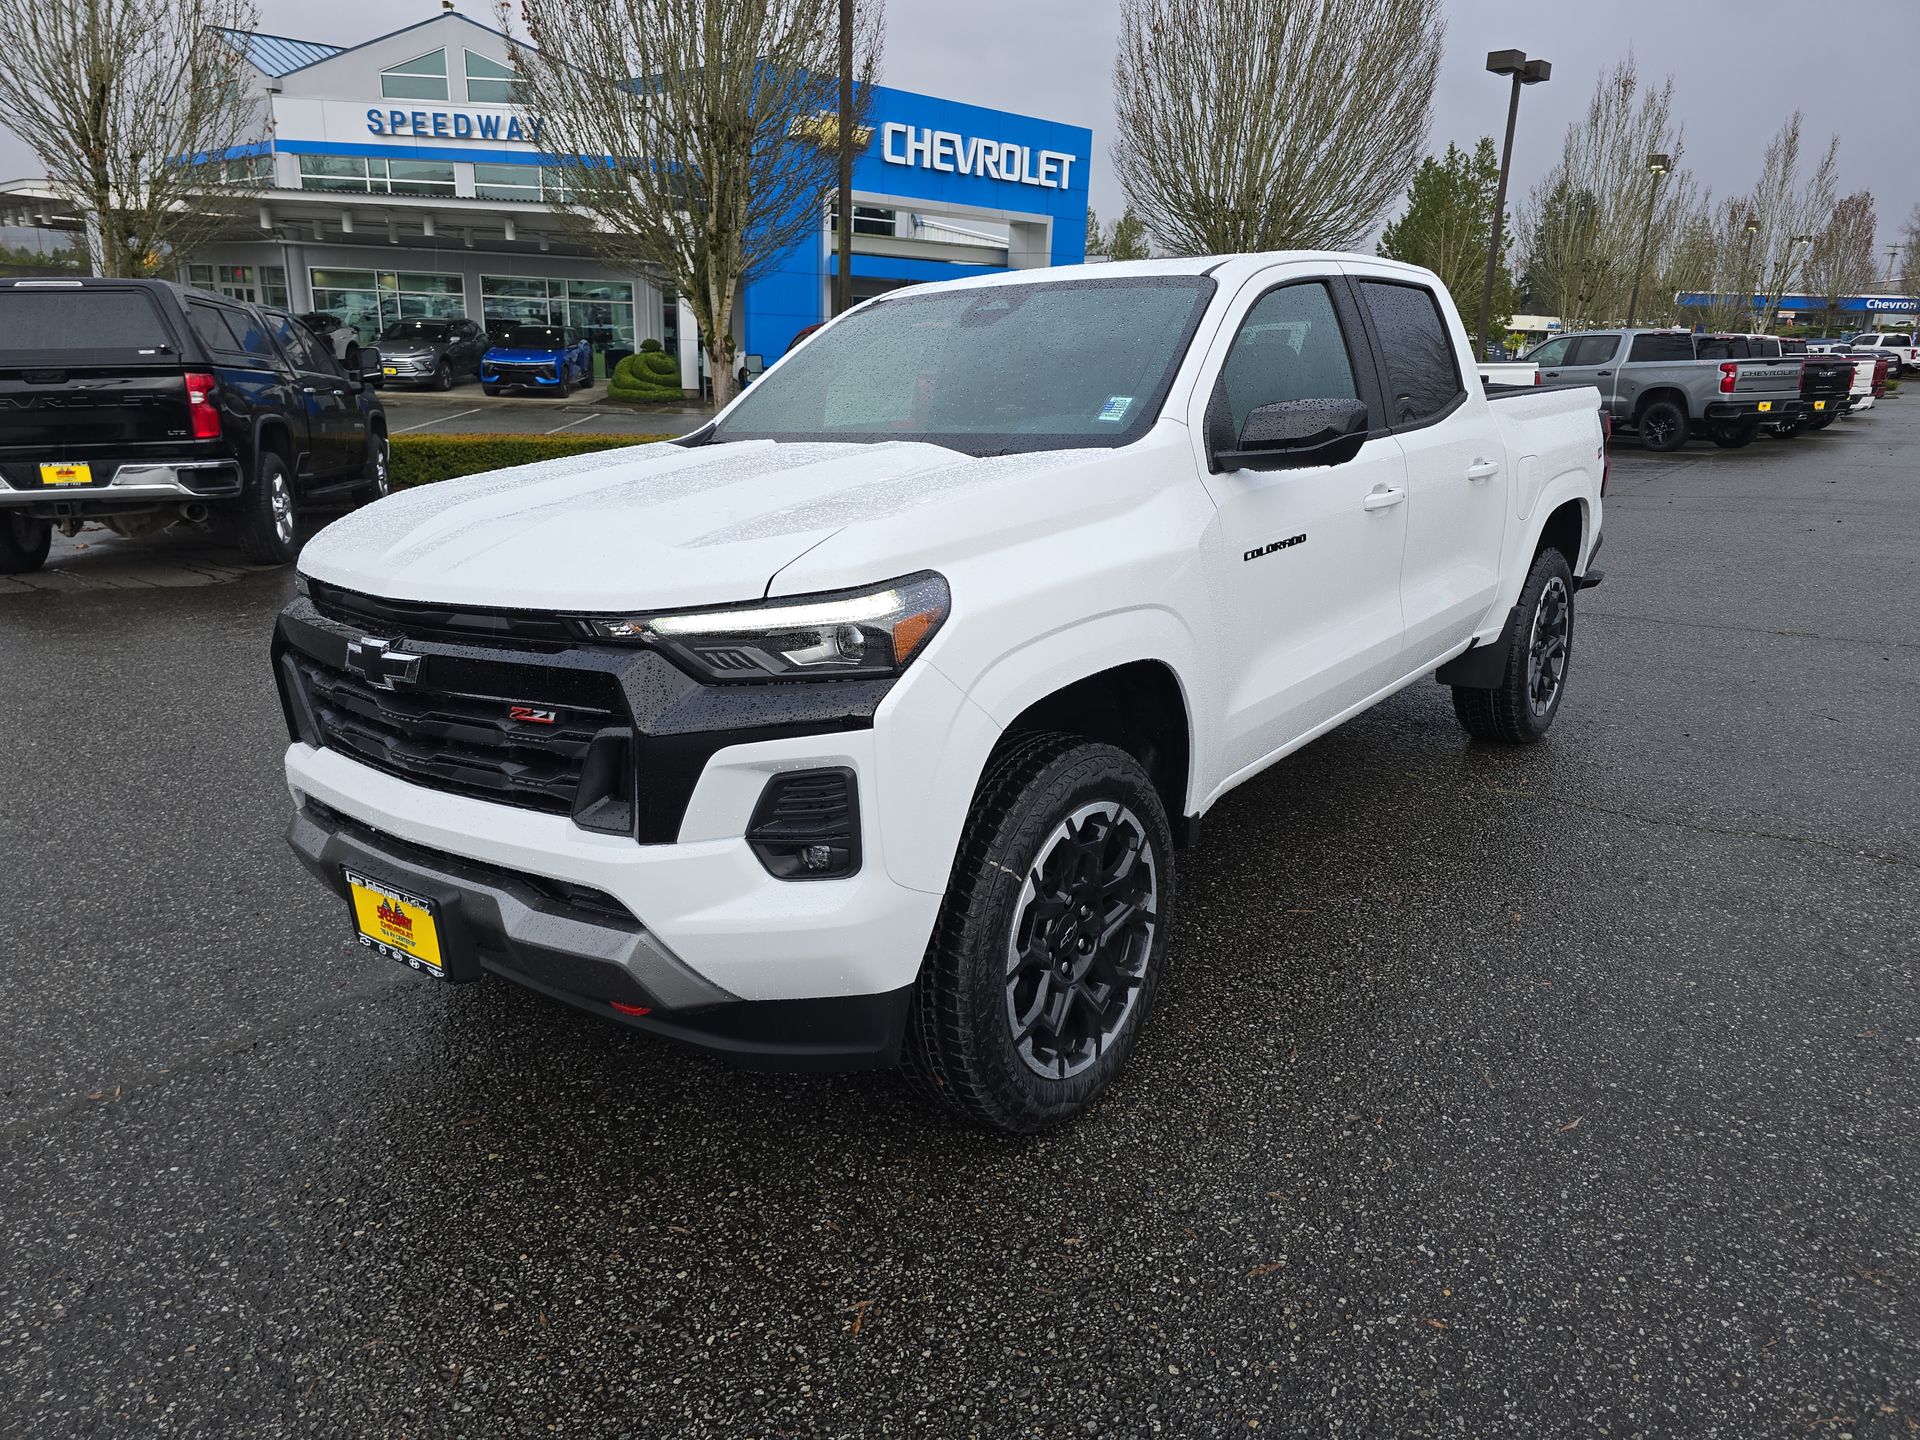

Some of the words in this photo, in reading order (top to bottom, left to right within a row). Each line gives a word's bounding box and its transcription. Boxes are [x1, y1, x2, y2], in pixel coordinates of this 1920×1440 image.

[367, 109, 545, 141] SPEEDWAY
[882, 121, 1076, 189] CHEVROLET
[1866, 299, 1917, 310] Chevron
[1742, 369, 1798, 377] CHEVROLET
[1244, 534, 1307, 561] COLORADO
[509, 706, 556, 723] Z71
